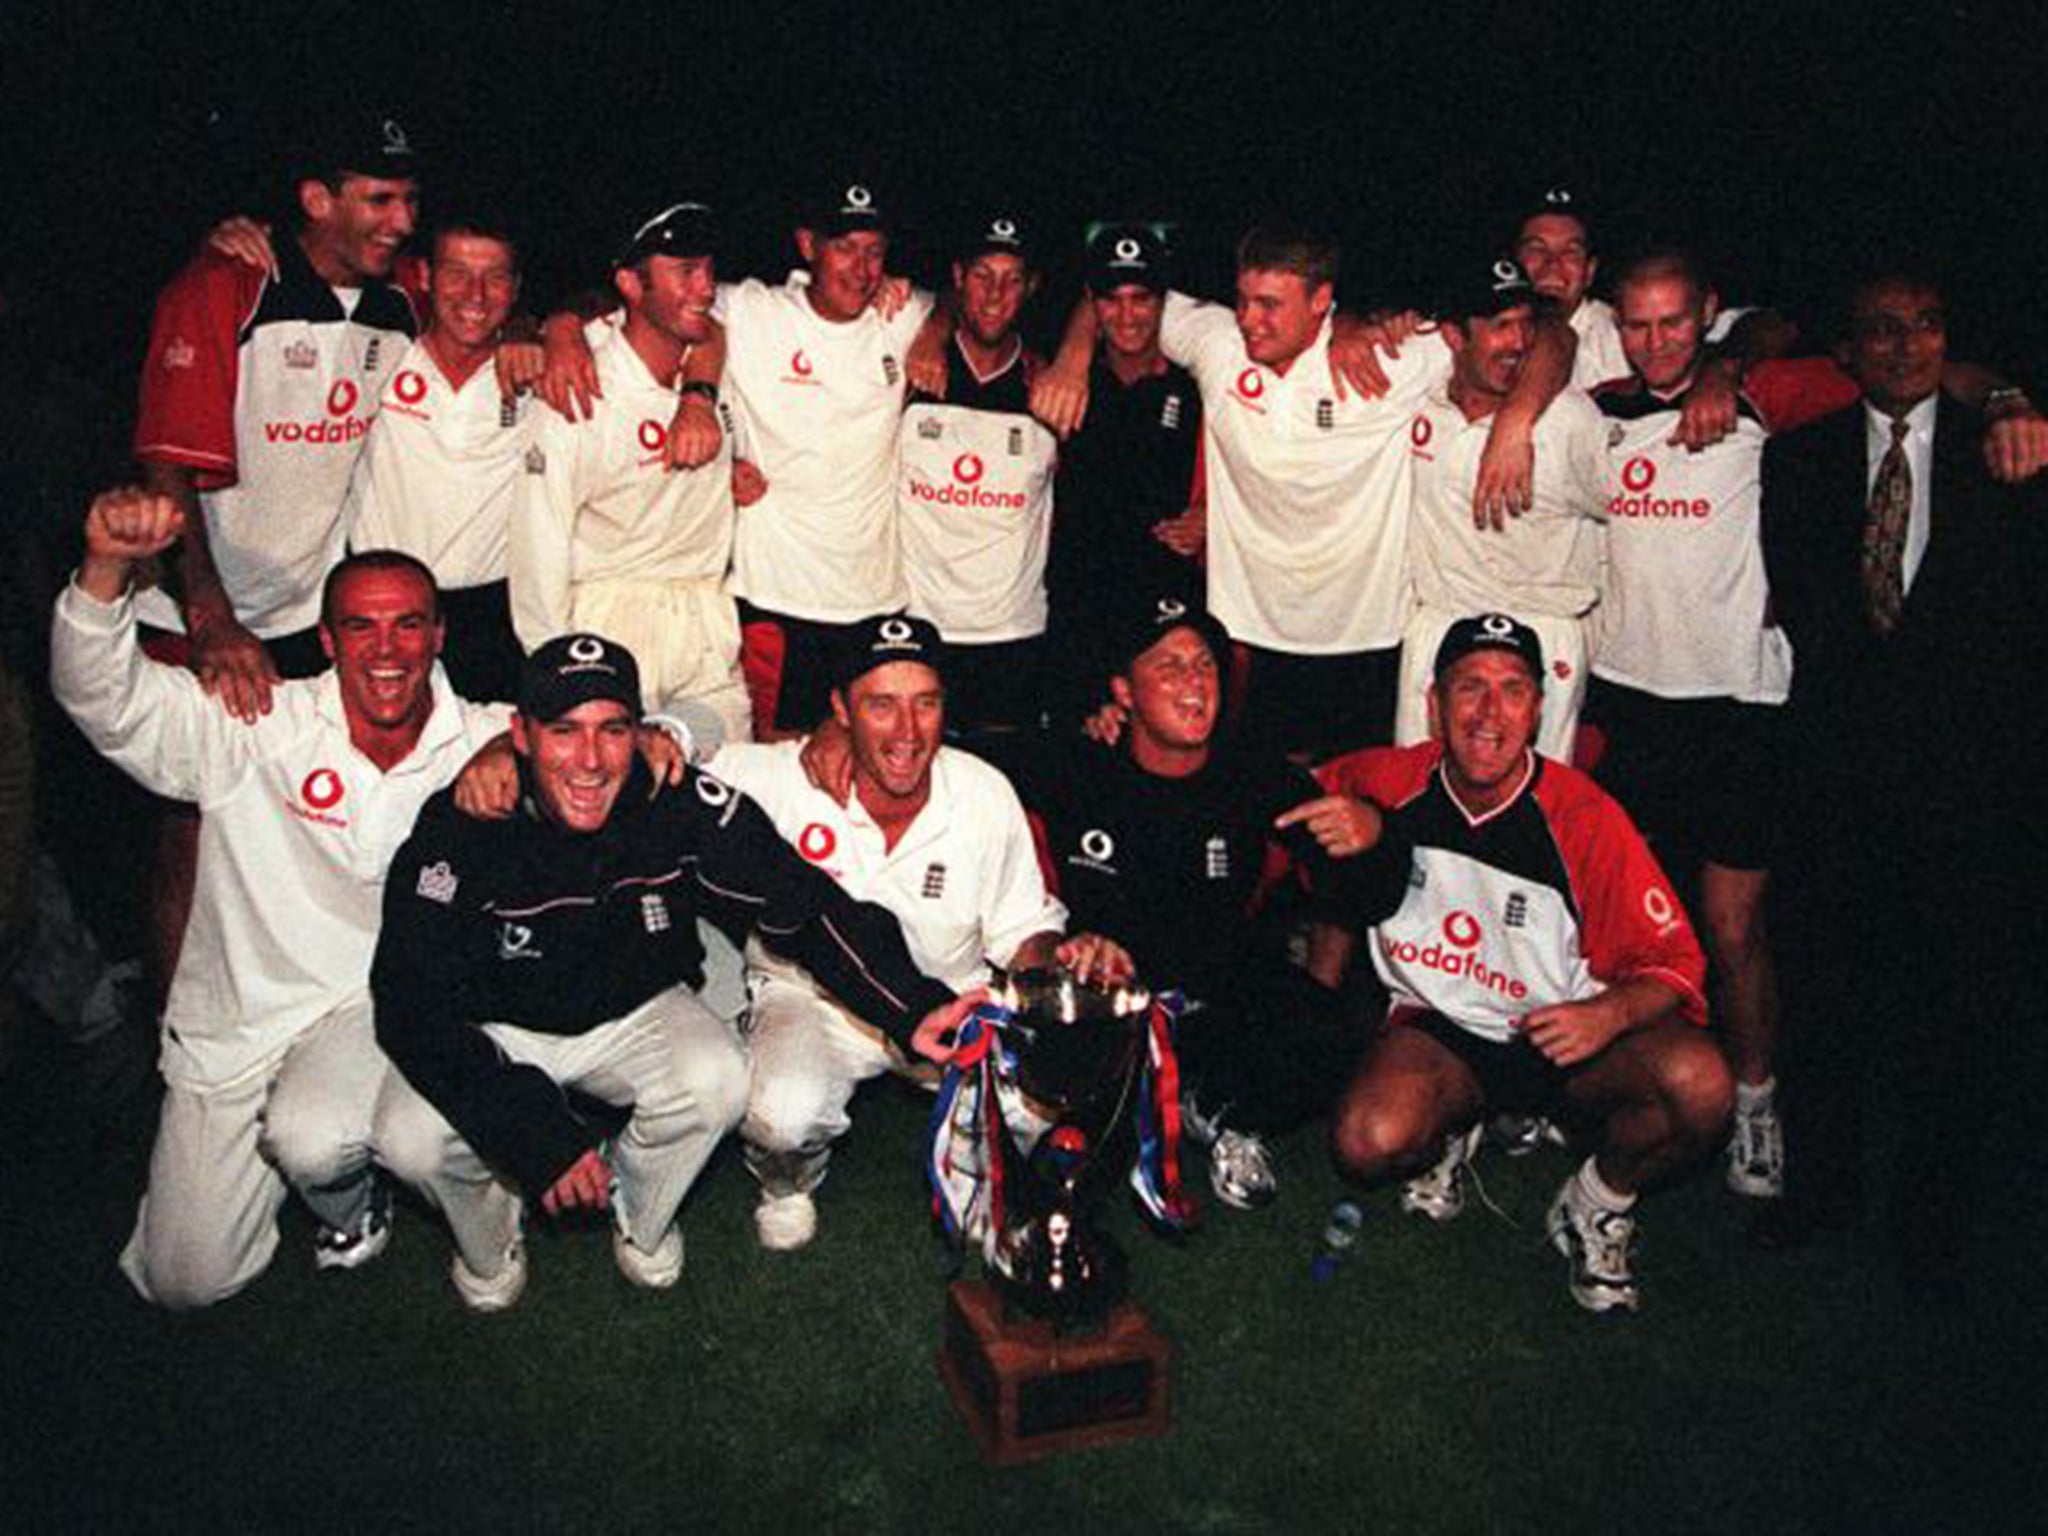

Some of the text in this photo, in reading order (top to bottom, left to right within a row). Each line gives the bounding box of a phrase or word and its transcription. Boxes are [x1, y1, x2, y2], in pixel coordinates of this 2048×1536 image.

[265, 415, 367, 443] vodafo
[910, 480, 1026, 508] vodafone
[1606, 491, 1710, 518] dafone
[1384, 936, 1527, 999] vodafone
